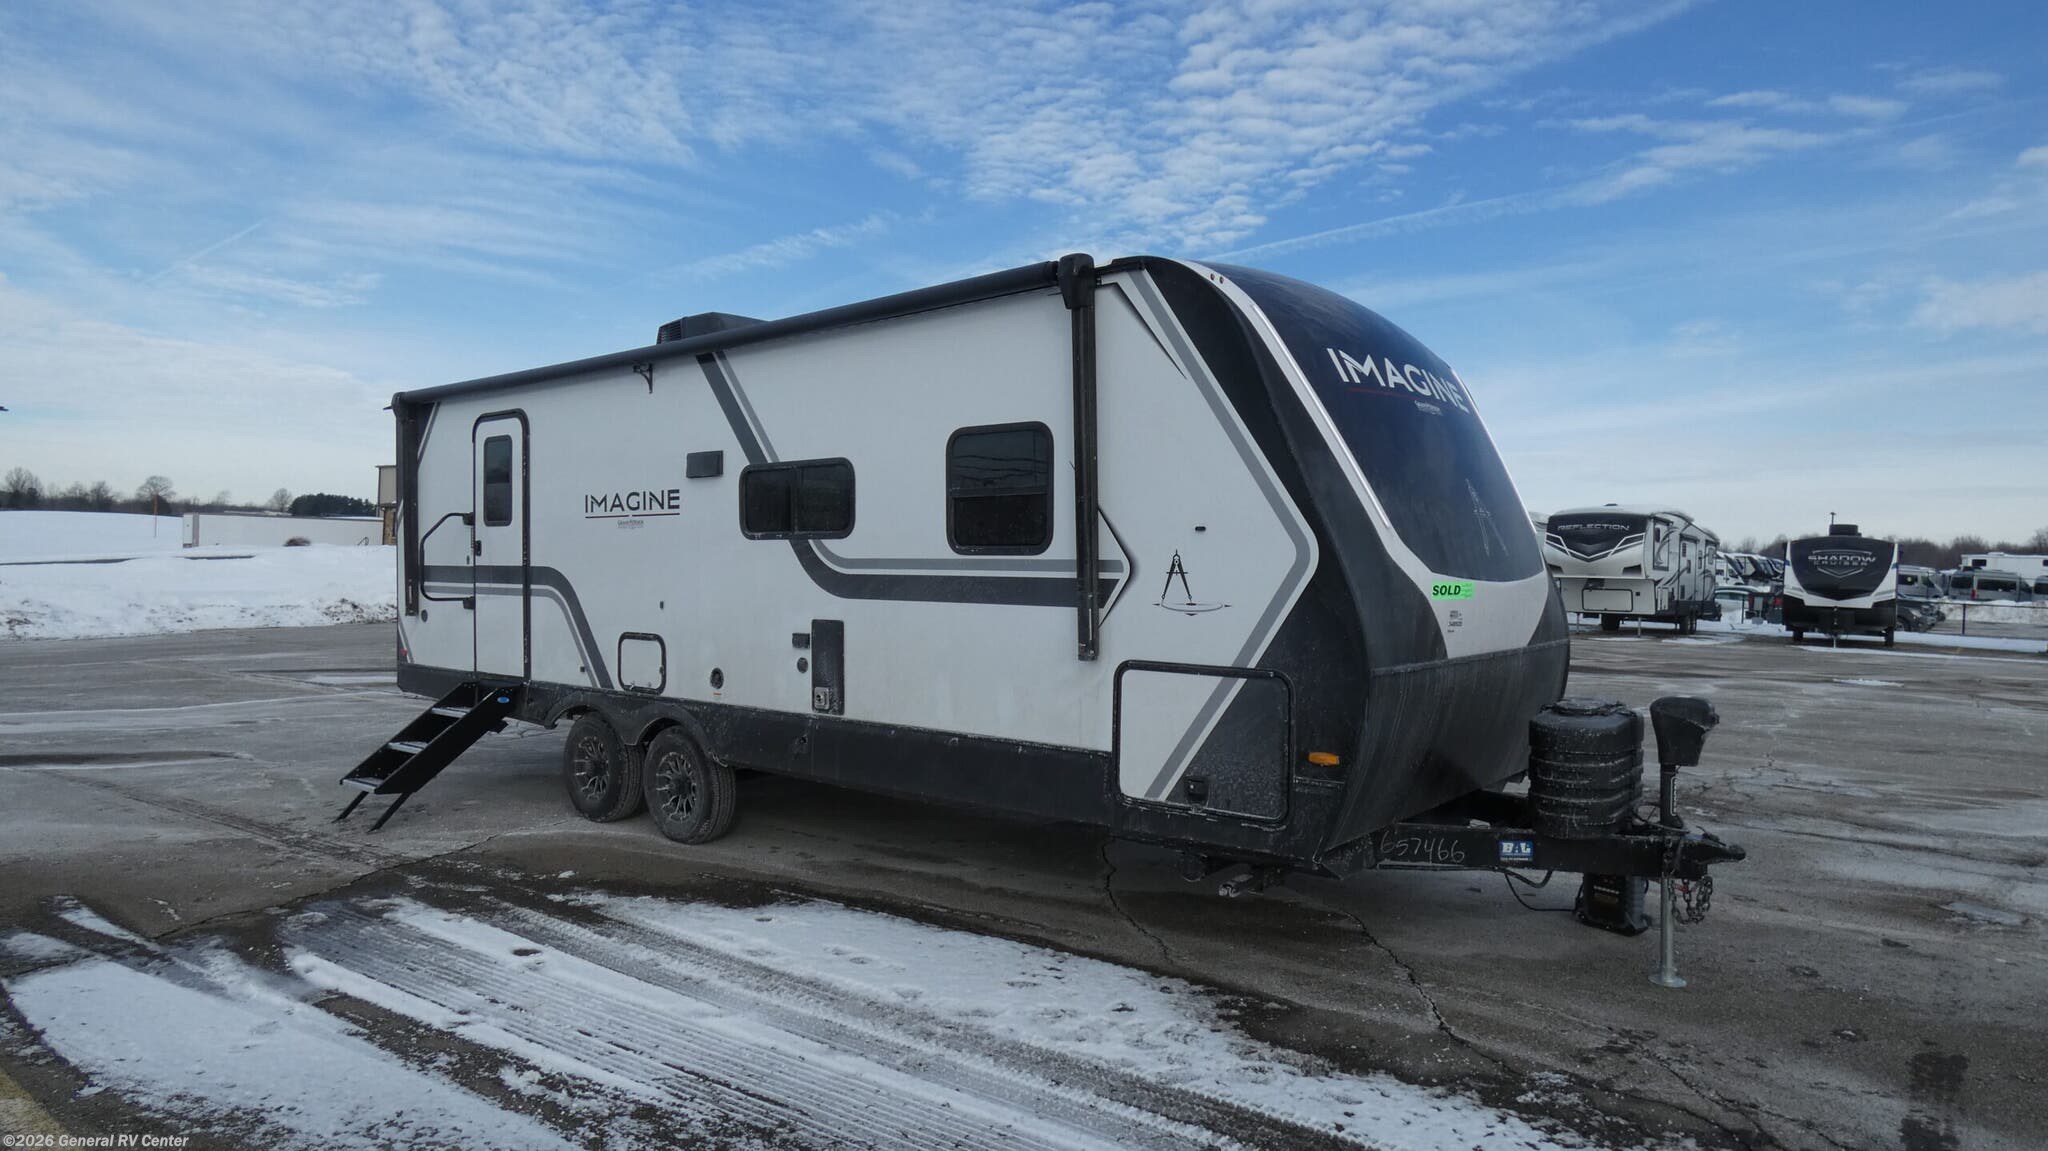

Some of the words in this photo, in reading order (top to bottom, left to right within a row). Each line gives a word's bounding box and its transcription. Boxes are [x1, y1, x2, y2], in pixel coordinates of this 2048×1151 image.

[1327, 347, 1470, 414] IMAGINE
[585, 489, 680, 513] IMAGINE
[1557, 523, 1630, 531] REFLECTION
[1808, 555, 1876, 563] SHADOW
[1432, 585, 1462, 596] SOLD
[1380, 831, 1465, 864] 657466
